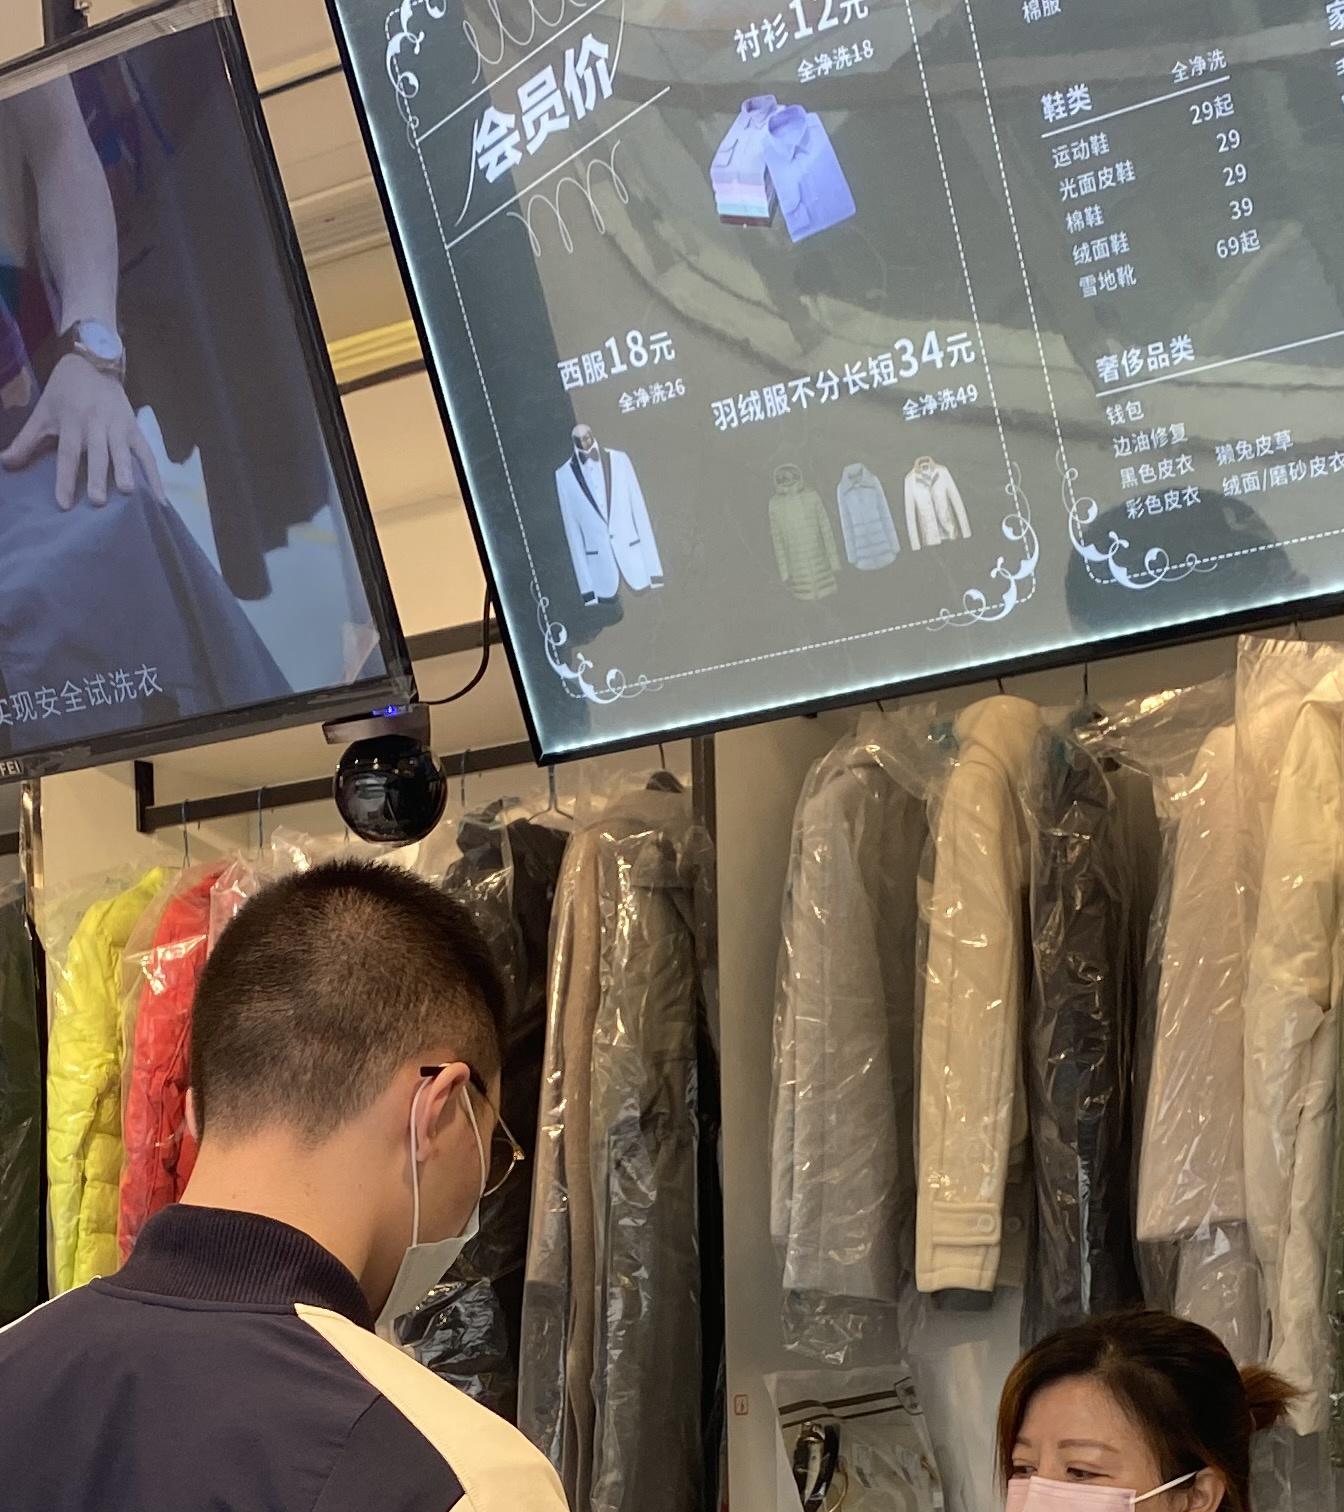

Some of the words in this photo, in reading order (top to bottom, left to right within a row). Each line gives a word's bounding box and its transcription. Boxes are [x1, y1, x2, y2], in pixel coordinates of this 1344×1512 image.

[734, 0, 868, 61] 衬衫12元
[797, 40, 874, 83] 全净洗18
[1170, 48, 1227, 84] 全净洗
[476, 33, 613, 183] 会员价
[1040, 83, 1093, 123] 鞋类
[1190, 93, 1235, 125] 29起
[1052, 131, 1110, 168] 运动鞋
[1216, 128, 1241, 153] 29
[1059, 159, 1136, 201] 光面皮鞋
[1222, 163, 1247, 187] 29
[1065, 203, 1105, 234] 棉鞋
[1229, 197, 1254, 221] 39
[1072, 231, 1130, 266] 绒面鞋
[1216, 229, 1261, 259] 69起
[1078, 263, 1137, 299] 雪地靴
[557, 328, 676, 391] 西服18元
[1095, 333, 1196, 384] 奢侈品类
[617, 376, 686, 415] 全净洗26
[711, 330, 976, 431] 羽绒服不分长短34元
[901, 384, 979, 422] 全净洗49
[1105, 399, 1145, 427] 钱包
[1112, 422, 1188, 459] 边油修复
[1119, 453, 1195, 489] 黑色皮衣
[1126, 485, 1201, 520] 彩色皮衣
